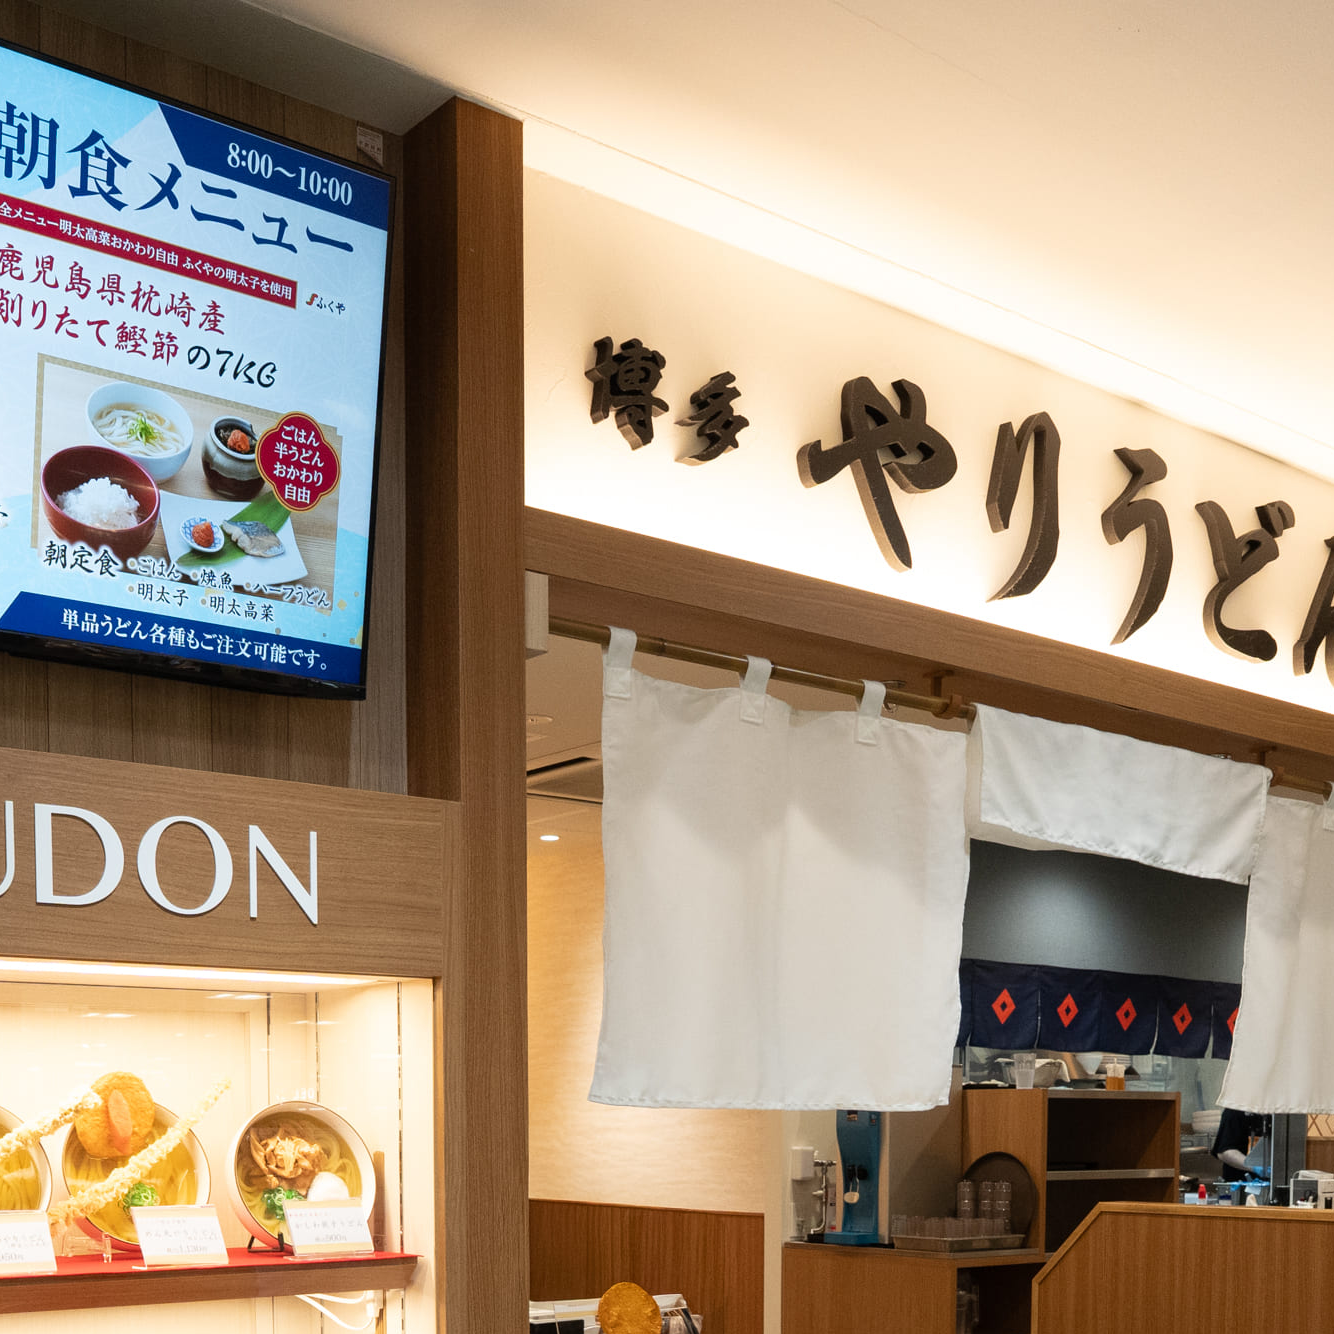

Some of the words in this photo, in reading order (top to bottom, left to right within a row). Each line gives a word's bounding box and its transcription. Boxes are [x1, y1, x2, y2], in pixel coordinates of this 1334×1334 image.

[0, 202, 178, 267] 全メニュー明太高菜おかわり自由
[182, 257, 292, 300] ふくやの明太子を使用
[316, 297, 346, 314] ふくや
[584, 335, 749, 466] 博多
[281, 424, 321, 448] ごはん
[273, 442, 325, 469] 半うどん
[272, 461, 324, 488] おかわり
[284, 483, 311, 504] 自由
[44, 540, 121, 578] 朝定食
[137, 557, 181, 580] ごはん
[198, 568, 233, 591] 焼魚
[251, 579, 331, 609] ハーフうどん
[136, 581, 190, 607] 明太子
[208, 594, 276, 622] 明太高菜
[60, 607, 329, 672] 単品うどん各種もご注文可能です。
